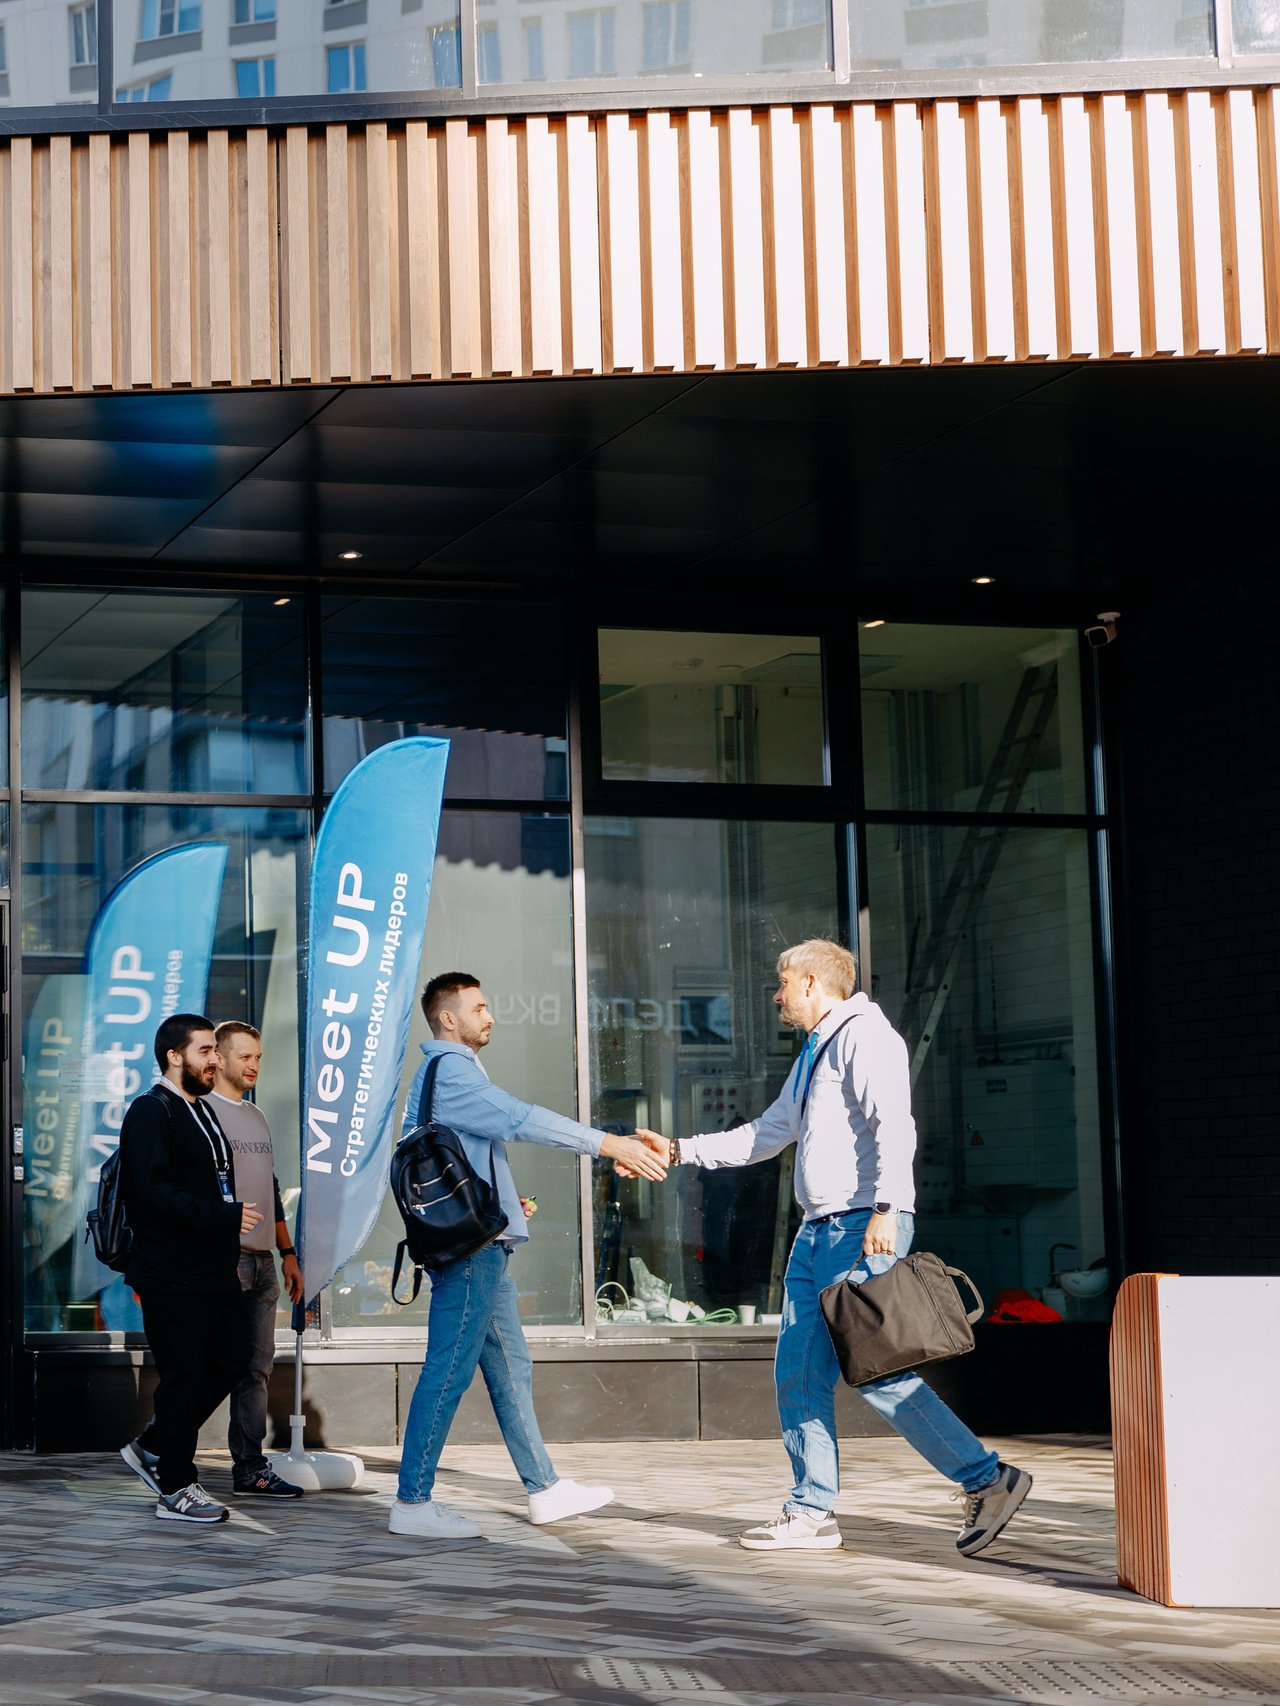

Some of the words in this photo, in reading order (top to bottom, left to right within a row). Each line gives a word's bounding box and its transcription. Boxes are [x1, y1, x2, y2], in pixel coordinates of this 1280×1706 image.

[326, 862, 376, 967] UP
[104, 945, 155, 1024] UP
[159, 949, 184, 1025] идеров
[339, 979, 391, 1177] Стратегических
[379, 872, 408, 976] лидеров
[306, 988, 359, 1174] Meet
